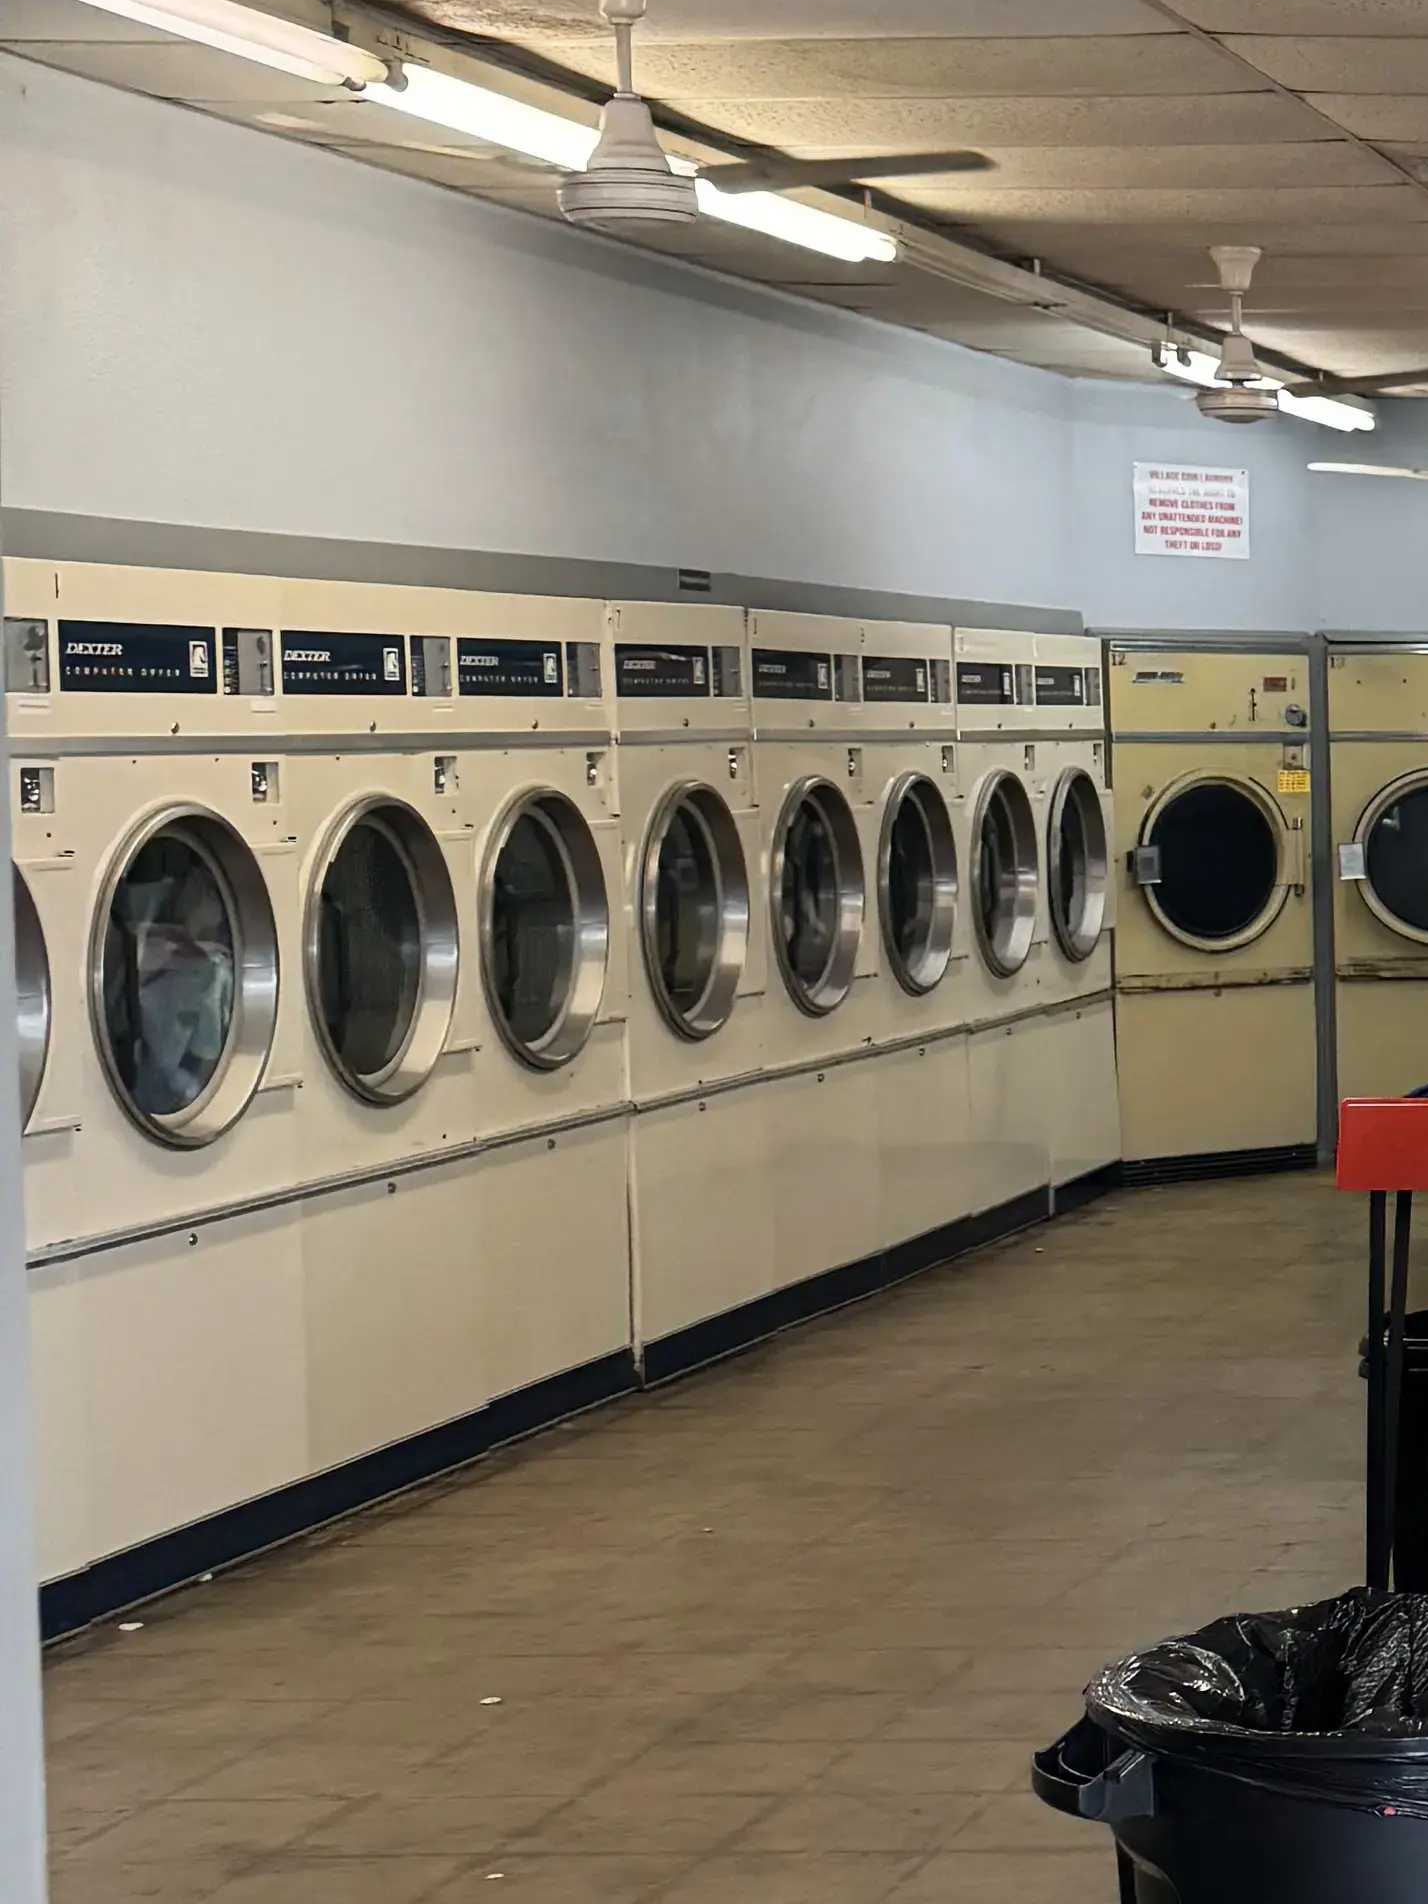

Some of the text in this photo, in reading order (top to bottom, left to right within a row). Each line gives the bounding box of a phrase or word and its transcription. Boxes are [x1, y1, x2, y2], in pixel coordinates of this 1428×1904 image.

[65, 642, 123, 656] DEXTER
[284, 650, 331, 662] DEXTER
[460, 656, 499, 667] DEXTER
[1111, 653, 1127, 666] 12
